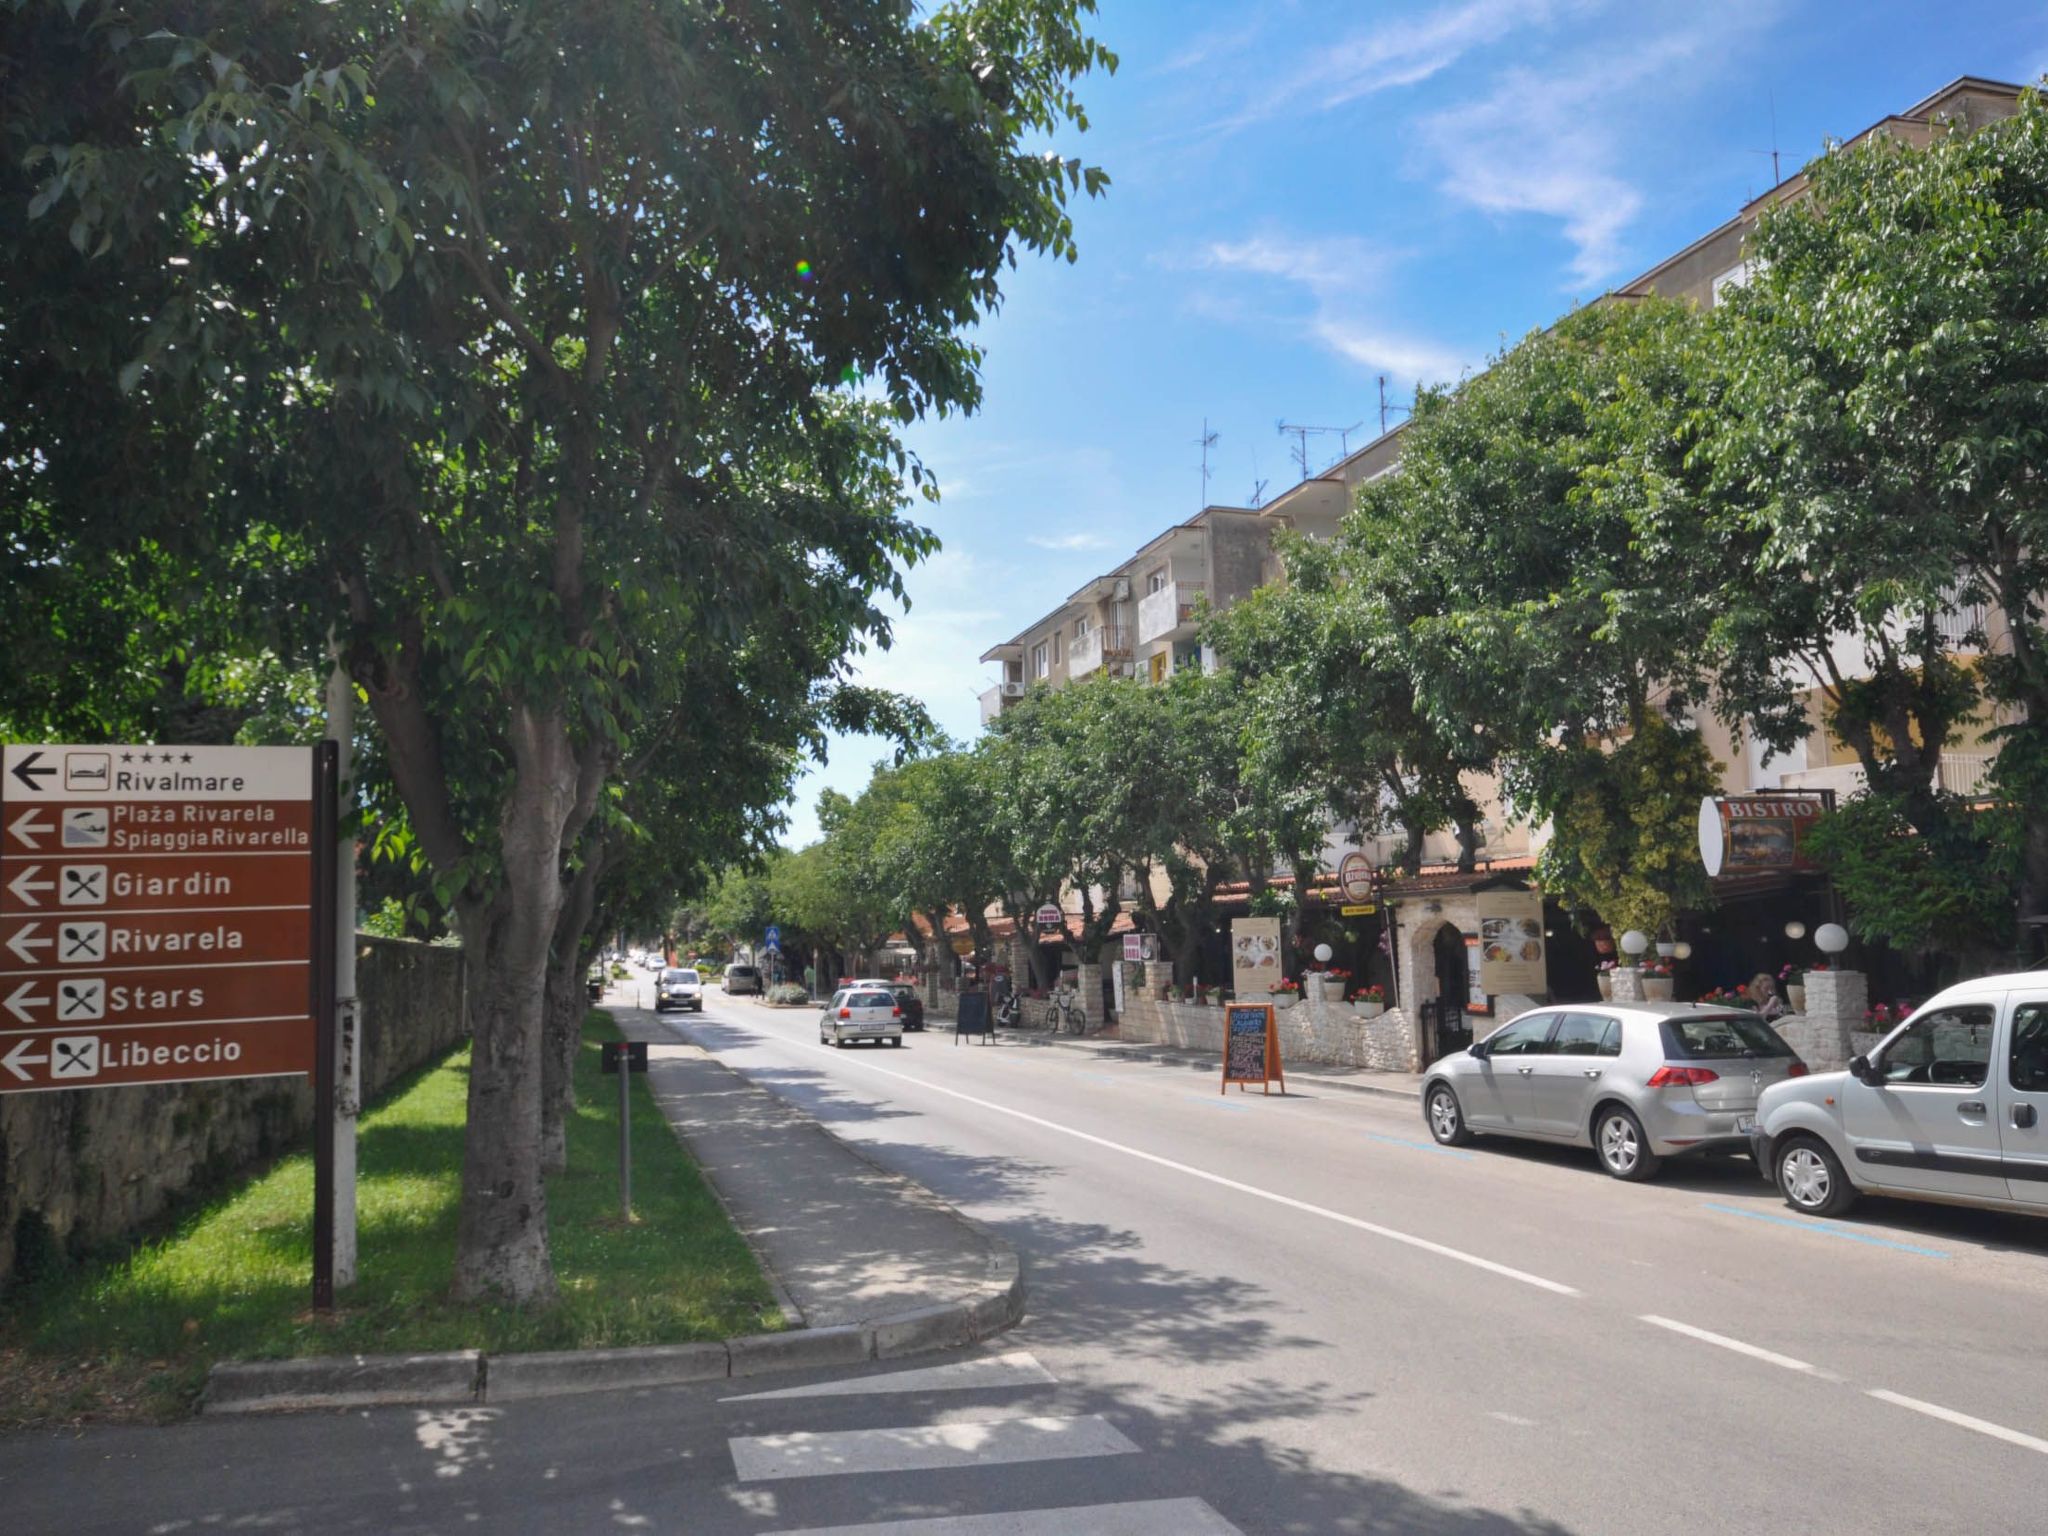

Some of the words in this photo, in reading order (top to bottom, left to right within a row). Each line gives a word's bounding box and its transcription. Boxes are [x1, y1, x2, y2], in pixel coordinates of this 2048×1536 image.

[116, 771, 245, 792] Rivalmare
[112, 805, 176, 823] Plaža
[182, 804, 275, 822] Rivarela
[1728, 802, 1813, 818] BISTRO
[113, 828, 209, 850] Spiaggia
[211, 827, 309, 845] Rivarella
[113, 871, 231, 897] Giardin
[111, 926, 243, 953] Rivarela
[109, 986, 204, 1011] Stars
[102, 1037, 241, 1068] Libeccio
